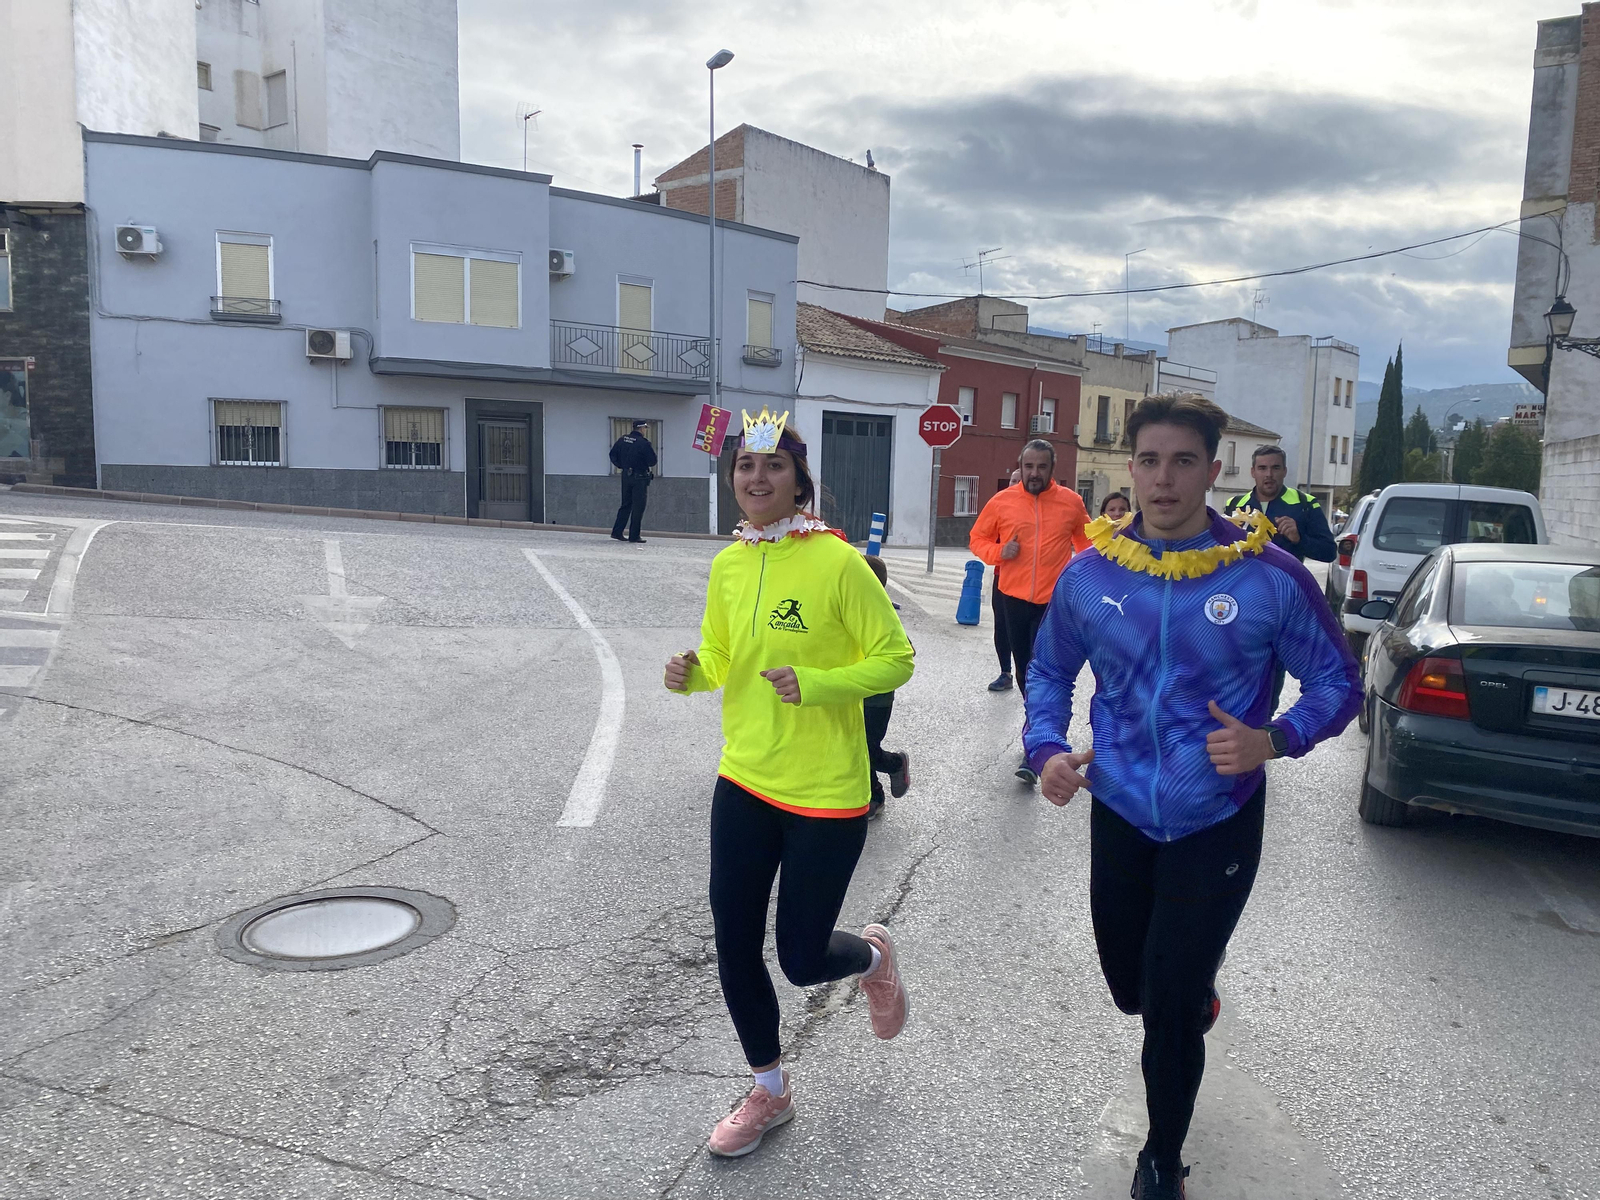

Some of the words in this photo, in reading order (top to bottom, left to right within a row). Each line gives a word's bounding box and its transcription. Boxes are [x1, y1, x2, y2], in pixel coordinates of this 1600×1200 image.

[702, 407, 721, 452] CIRCO
[923, 421, 957, 432] STOP
[1207, 594, 1236, 607] MANCHESTER
[1480, 681, 1508, 689] OPEL
